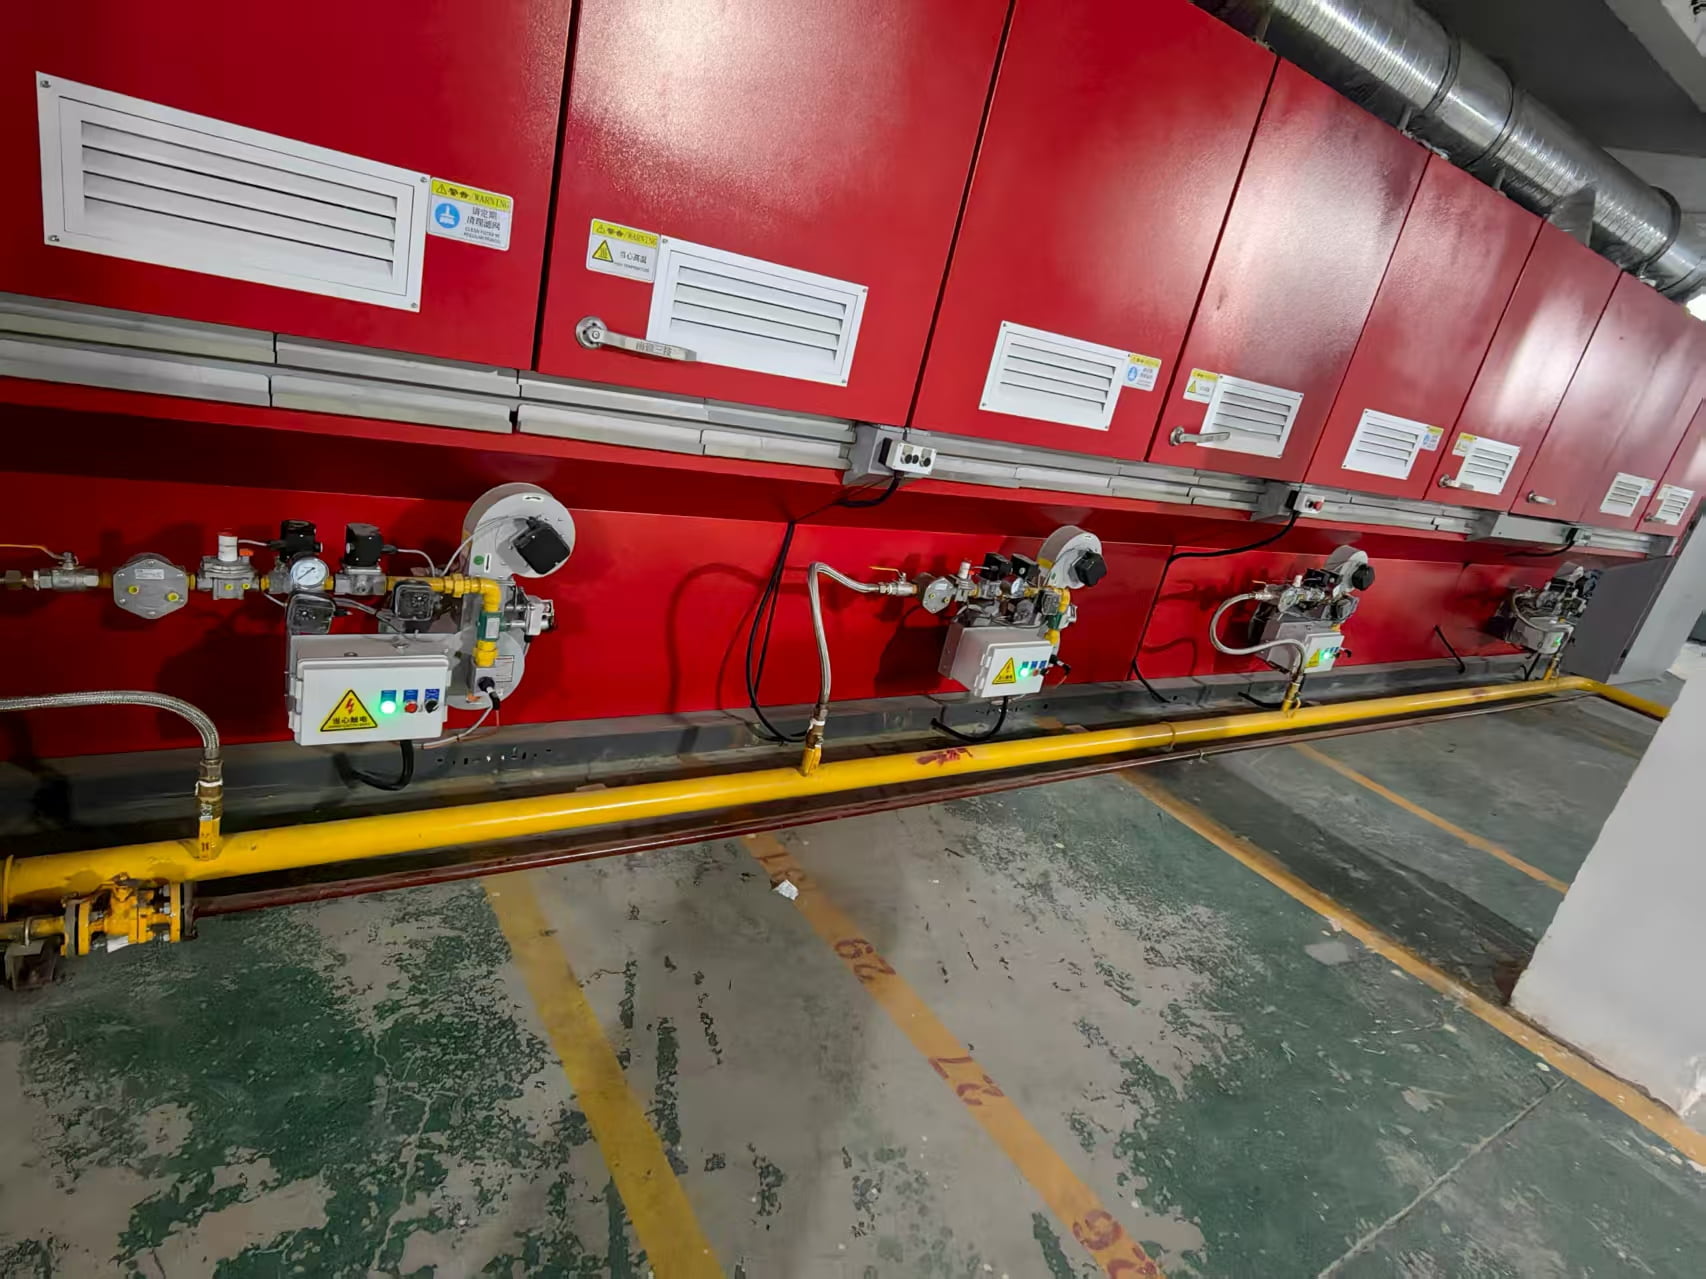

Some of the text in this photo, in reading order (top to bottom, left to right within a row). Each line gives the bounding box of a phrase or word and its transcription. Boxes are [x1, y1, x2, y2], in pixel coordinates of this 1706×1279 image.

[333, 716, 368, 725] 当心触电
[928, 1056, 1005, 1106] 27
